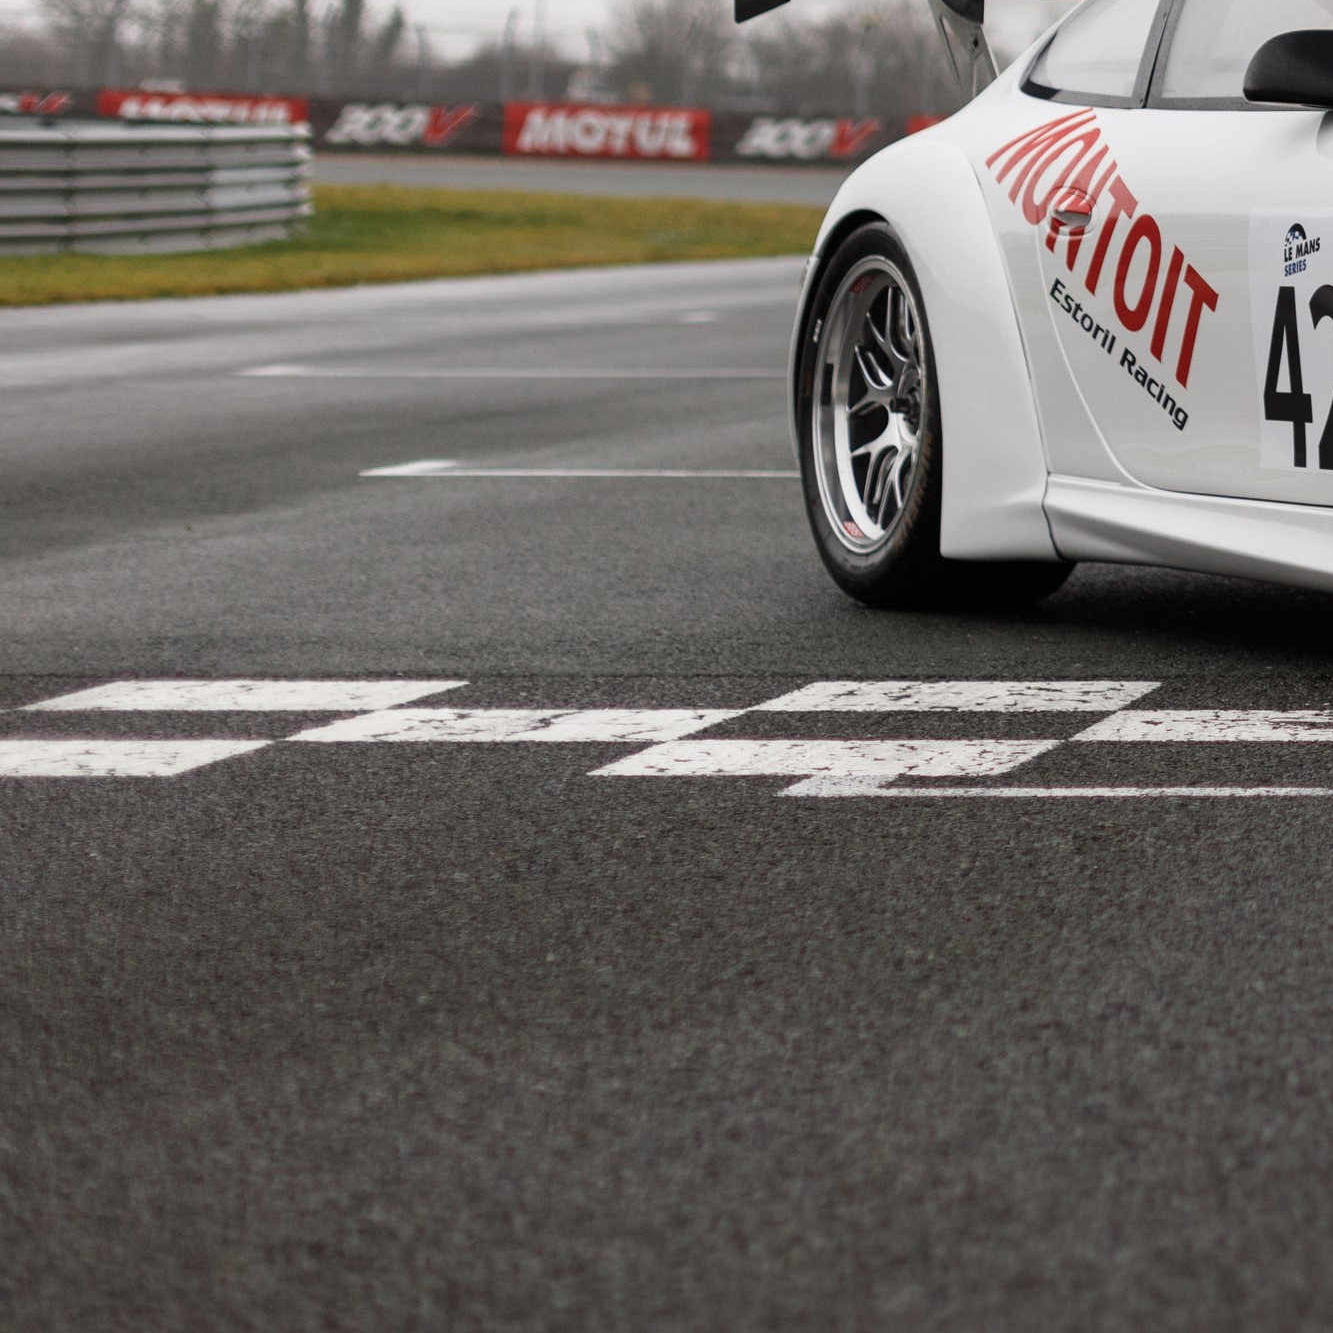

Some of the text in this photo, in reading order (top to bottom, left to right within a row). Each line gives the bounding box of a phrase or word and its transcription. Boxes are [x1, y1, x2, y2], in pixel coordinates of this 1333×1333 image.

[515, 107, 698, 157] MOTUL
[985, 107, 1219, 390] MONTOIT
[1284, 237, 1320, 262] LE MANS
[1284, 259, 1307, 277] SERIES
[1049, 278, 1189, 431] Estoril Racing
